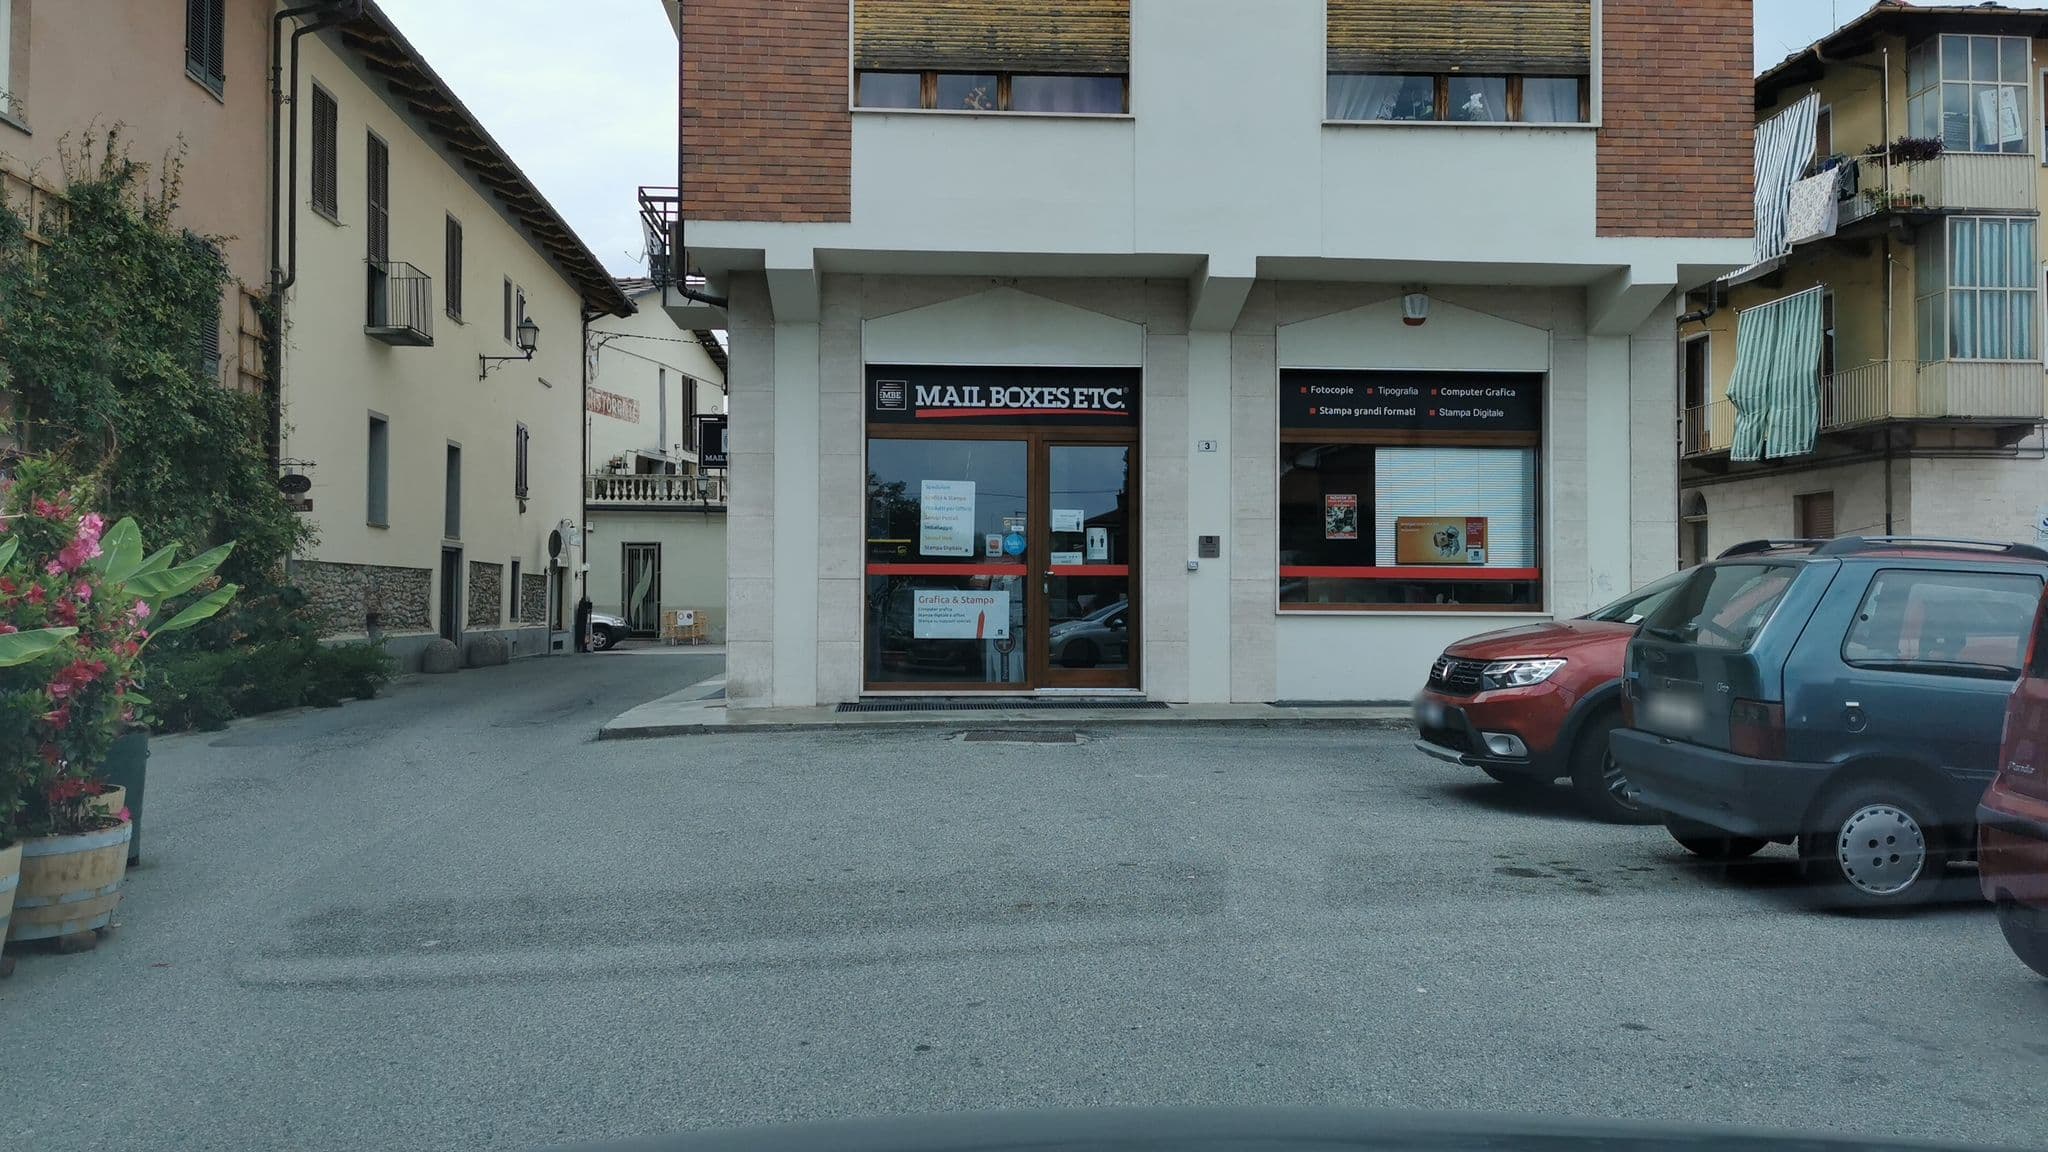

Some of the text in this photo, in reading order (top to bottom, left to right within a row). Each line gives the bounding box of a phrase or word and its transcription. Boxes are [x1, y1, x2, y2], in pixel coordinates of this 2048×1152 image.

[915, 385, 985, 407] MAIL
[989, 386, 1071, 409] BOXES
[1310, 385, 1516, 398] Fotocopie Tipografia Computer Grafica
[1319, 406, 1504, 419] Stampa grandi formati Stampa Digitale
[1204, 442, 1210, 450] 3
[705, 454, 725, 462] MAIL
[918, 596, 950, 604] Grafica
[961, 596, 994, 605] Stampa
